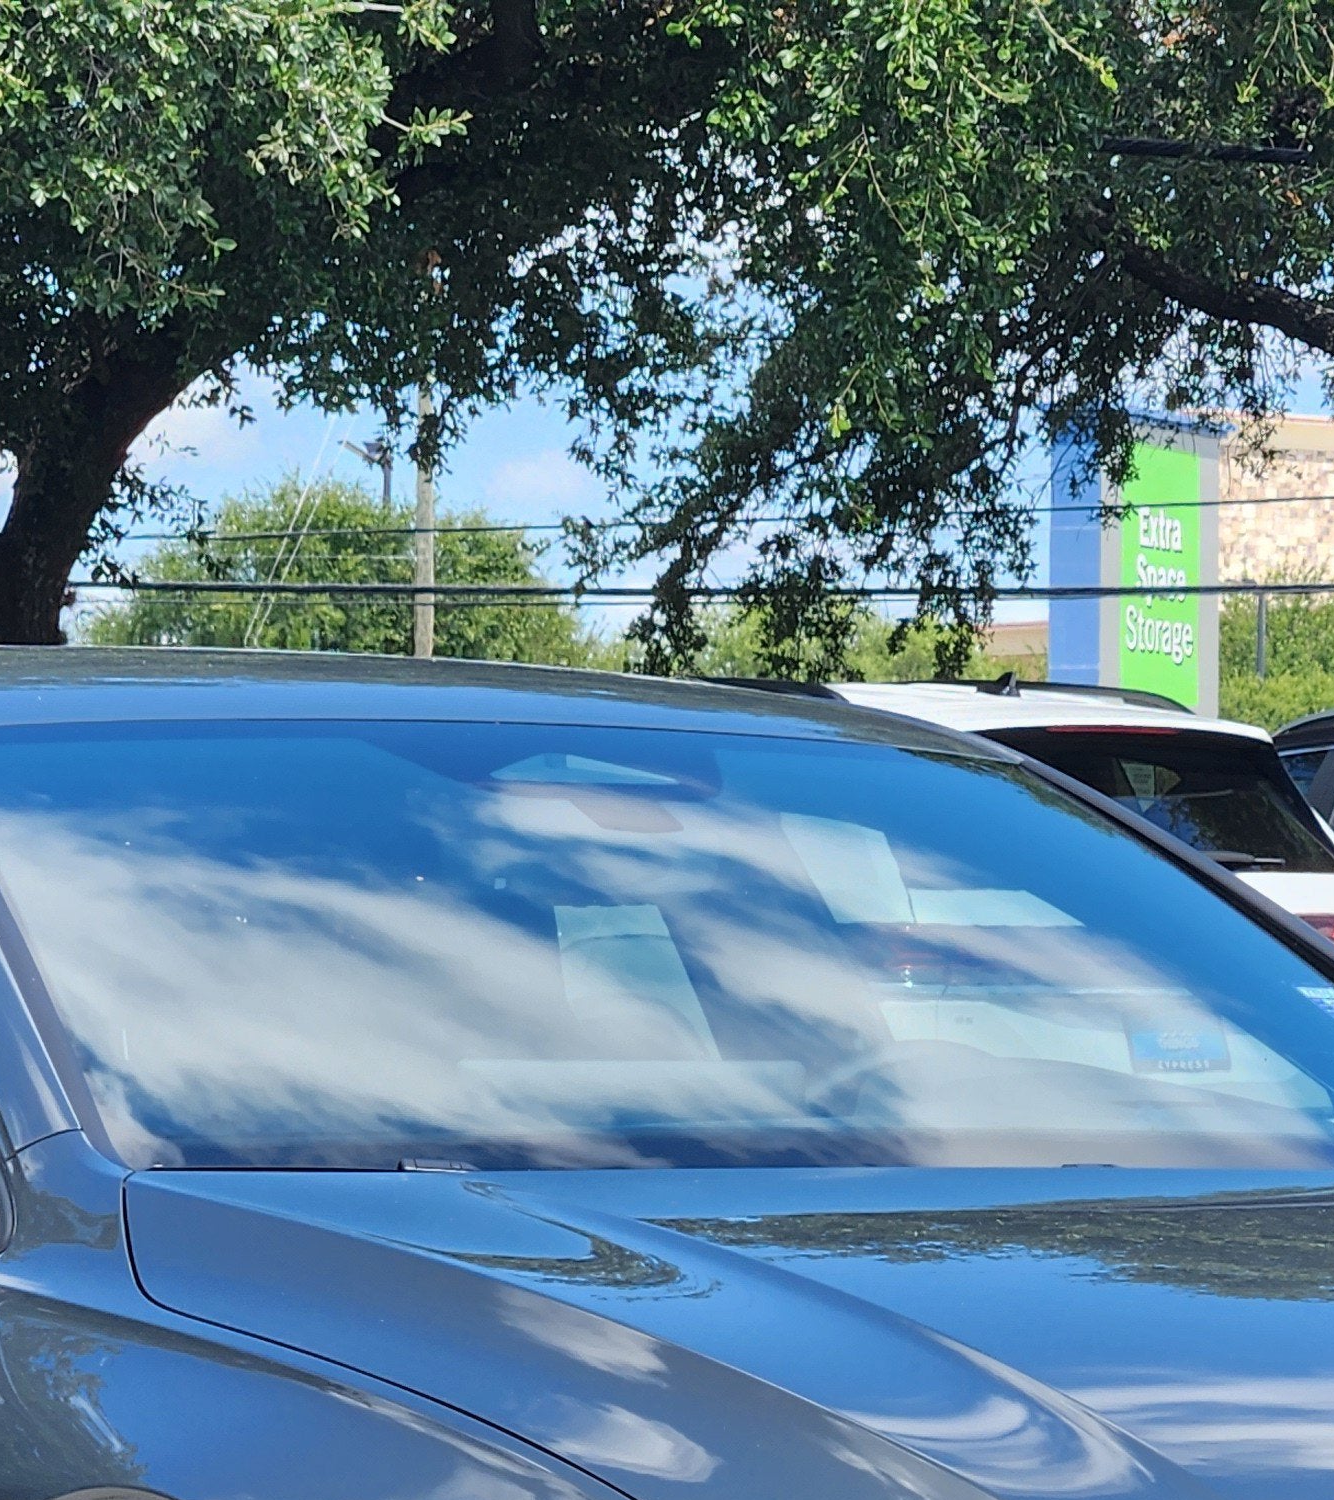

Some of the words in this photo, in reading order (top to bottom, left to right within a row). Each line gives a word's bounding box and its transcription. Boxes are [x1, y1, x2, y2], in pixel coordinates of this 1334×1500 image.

[1138, 505, 1183, 553] Extra
[1135, 552, 1188, 608] Space
[1124, 604, 1195, 666] Storage
